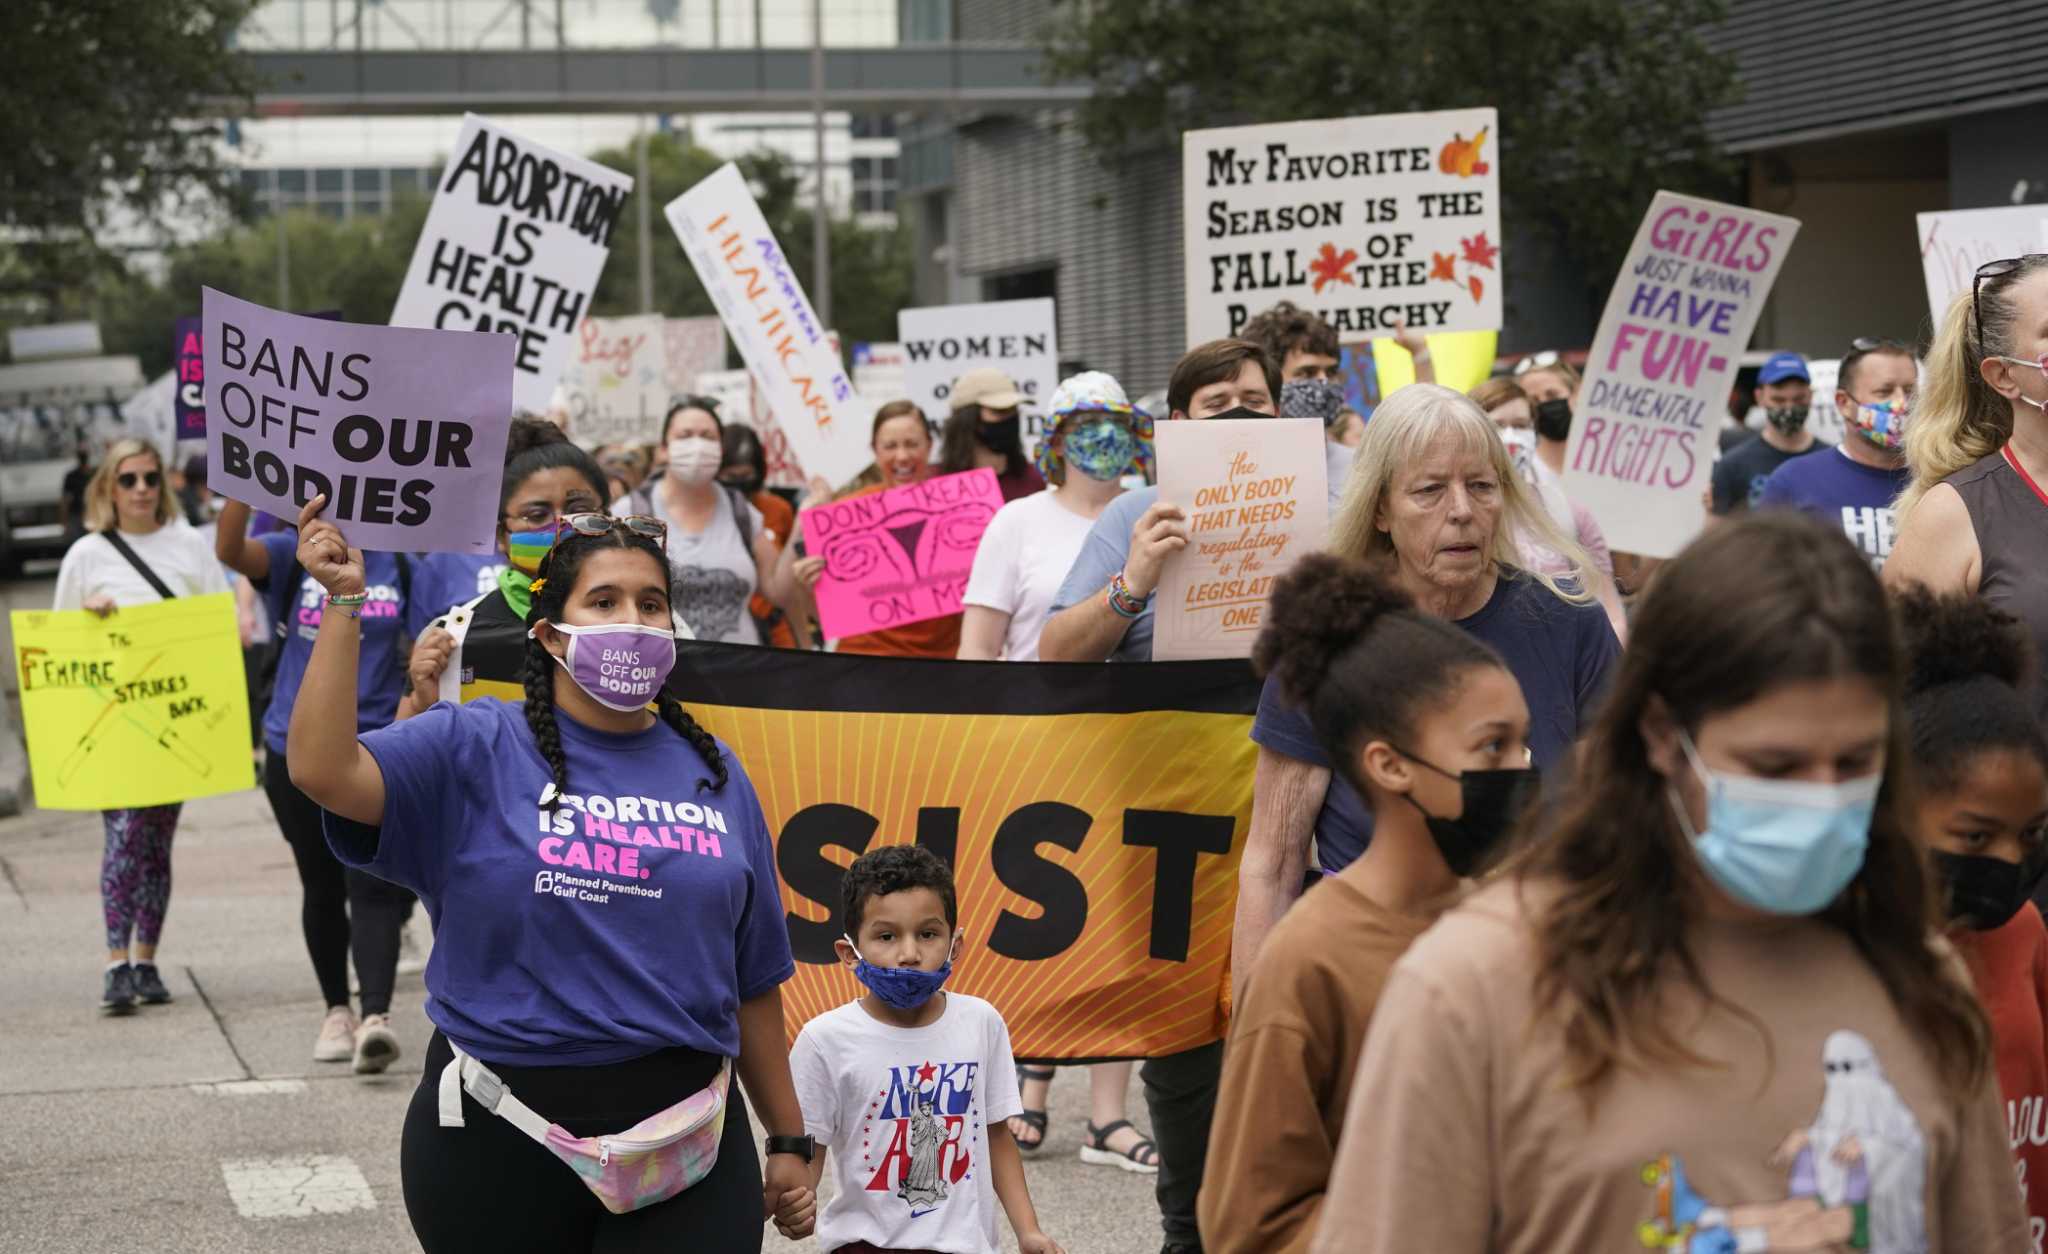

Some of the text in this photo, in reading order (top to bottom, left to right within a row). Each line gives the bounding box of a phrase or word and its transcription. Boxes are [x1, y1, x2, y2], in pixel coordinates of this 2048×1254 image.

[445, 129, 626, 247] ABORTION
[1207, 192, 1483, 239] SEASON IS THE
[491, 215, 542, 267] IS
[1367, 234, 1413, 259] OF
[427, 239, 584, 333] HEALTH
[1209, 250, 1306, 293] FALL
[1357, 262, 1429, 289] THE
[1634, 254, 1687, 283] JUST
[1227, 302, 1452, 338] PARCHY
[1628, 282, 1738, 335] HAVE
[222, 322, 372, 401] BANS
[905, 332, 1046, 361] WOMEN
[1607, 323, 1727, 389] FUN-
[1589, 379, 1706, 430] DAMENTAL
[220, 382, 474, 468] OFF OUR
[1228, 451, 1258, 482] the
[1573, 417, 1697, 490] RIGHTS
[222, 432, 436, 527] BODIES
[901, 473, 992, 508] TREAD
[1195, 476, 1296, 508] ONLY BODY
[1191, 500, 1297, 532] THAT NEEDS
[1199, 524, 1290, 563] regulating
[1238, 551, 1264, 577] the
[869, 590, 915, 625] ON
[1221, 606, 1263, 627] ONE
[600, 662, 657, 681] OFF OUR
[602, 648, 640, 665] BANS
[114, 676, 188, 703] STRIKES
[600, 675, 651, 695] BODIES
[169, 696, 208, 720] BACK
[539, 809, 723, 858] IS HEALTH
[538, 837, 651, 880] CARE.
[553, 885, 609, 904] Gulf Coast
[554, 872, 663, 899] Planned Parenthood
